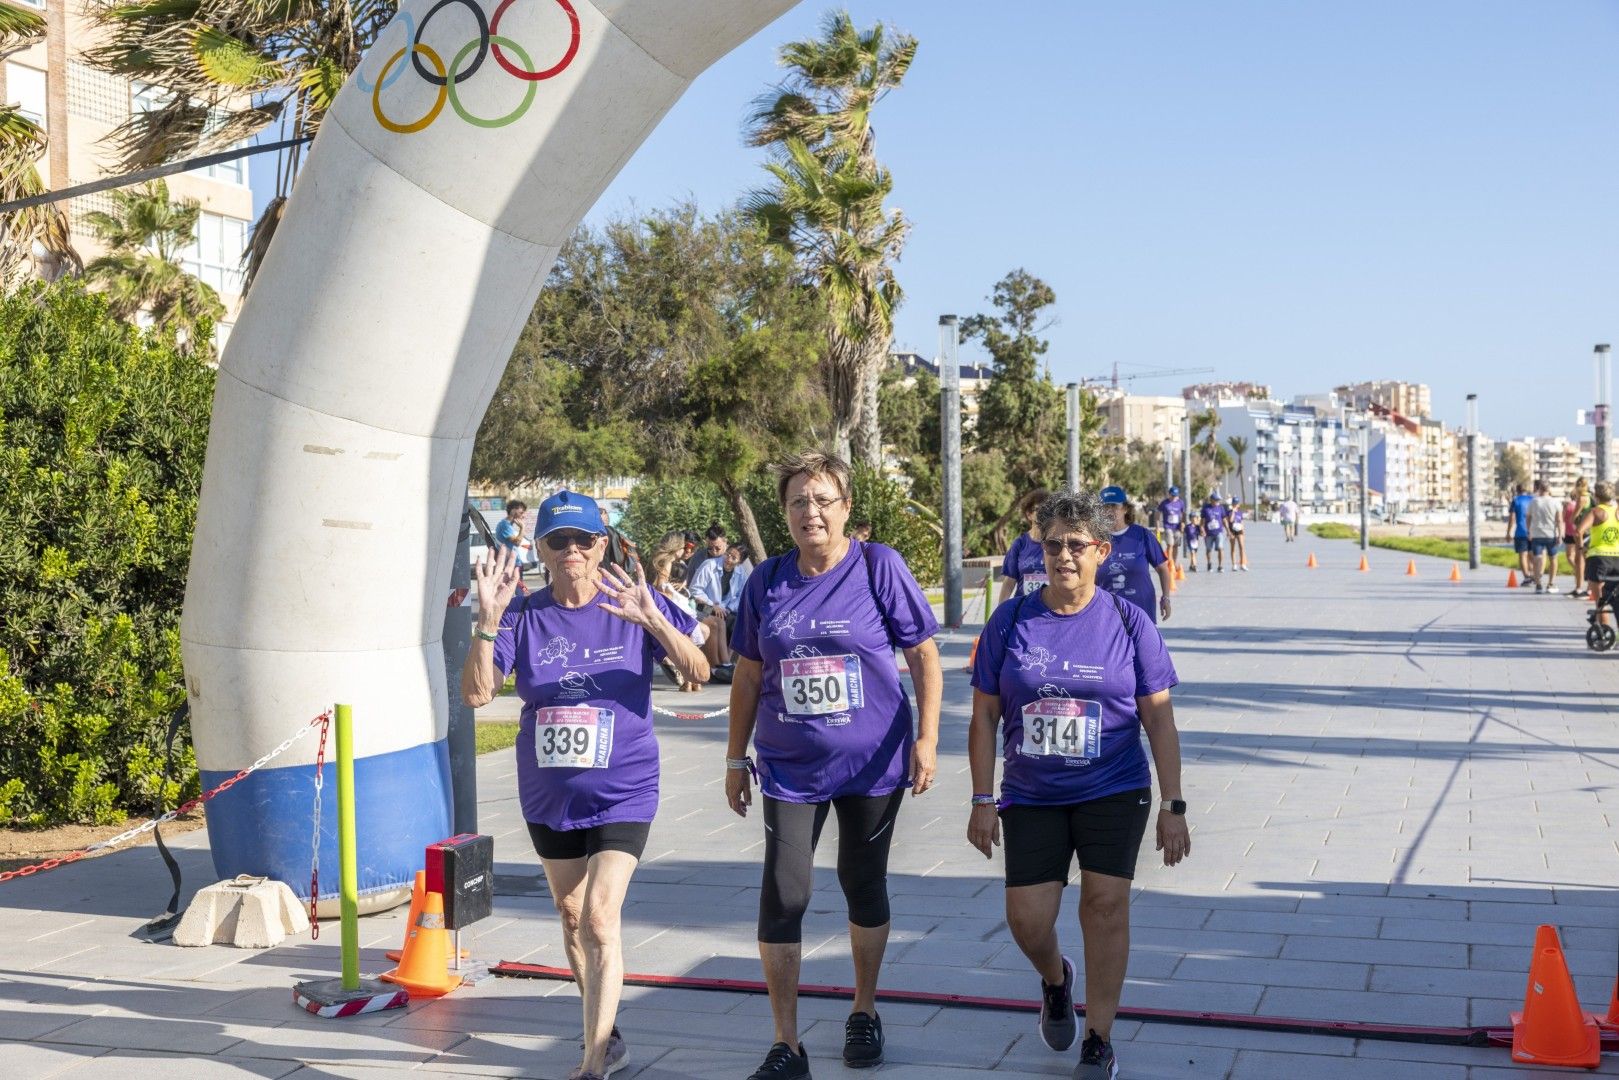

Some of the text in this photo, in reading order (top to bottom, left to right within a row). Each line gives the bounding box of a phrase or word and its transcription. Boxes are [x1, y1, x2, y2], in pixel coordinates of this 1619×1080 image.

[792, 675, 841, 705] 350
[848, 672, 860, 706] MARCHA
[542, 727, 589, 755] 339
[597, 728, 609, 764] MARCHA
[1031, 717, 1078, 746] 314
[1087, 719, 1097, 754] MARCHA
